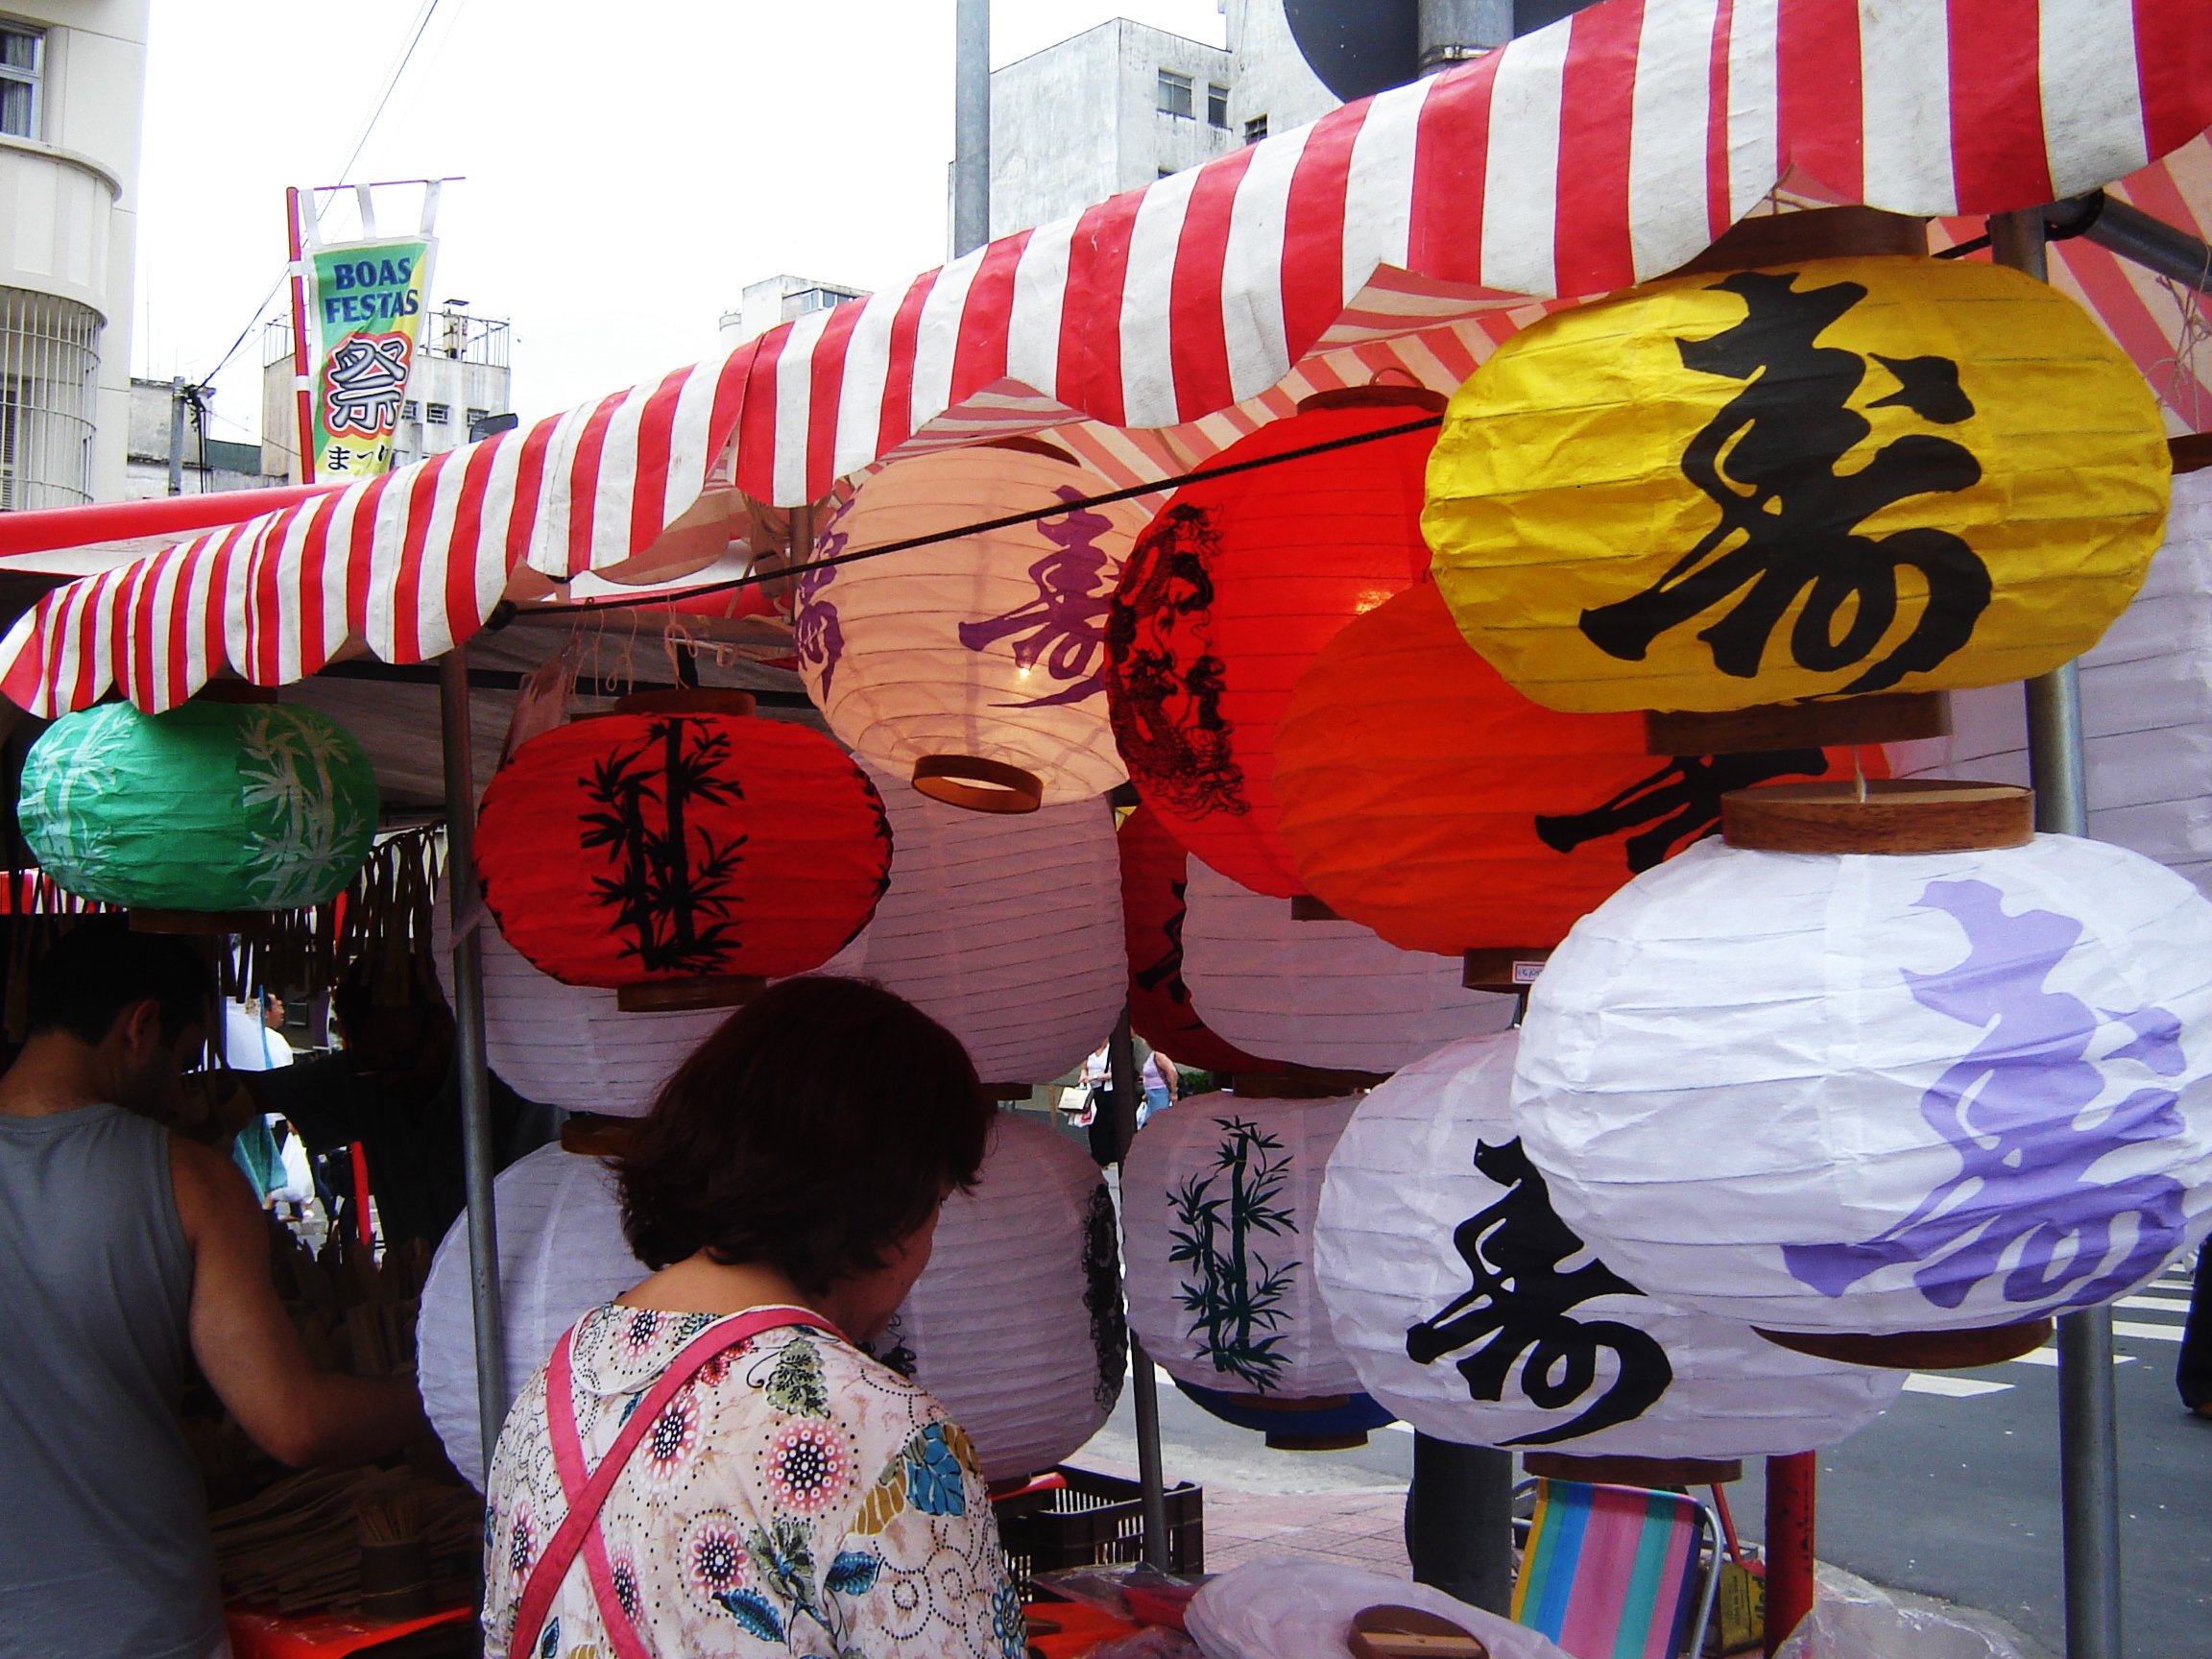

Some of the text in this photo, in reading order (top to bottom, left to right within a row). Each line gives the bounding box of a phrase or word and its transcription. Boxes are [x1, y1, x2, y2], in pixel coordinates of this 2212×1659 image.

[333, 257, 412, 291] BOAS
[325, 289, 419, 325] FESTAS
[330, 339, 407, 430] 祭
